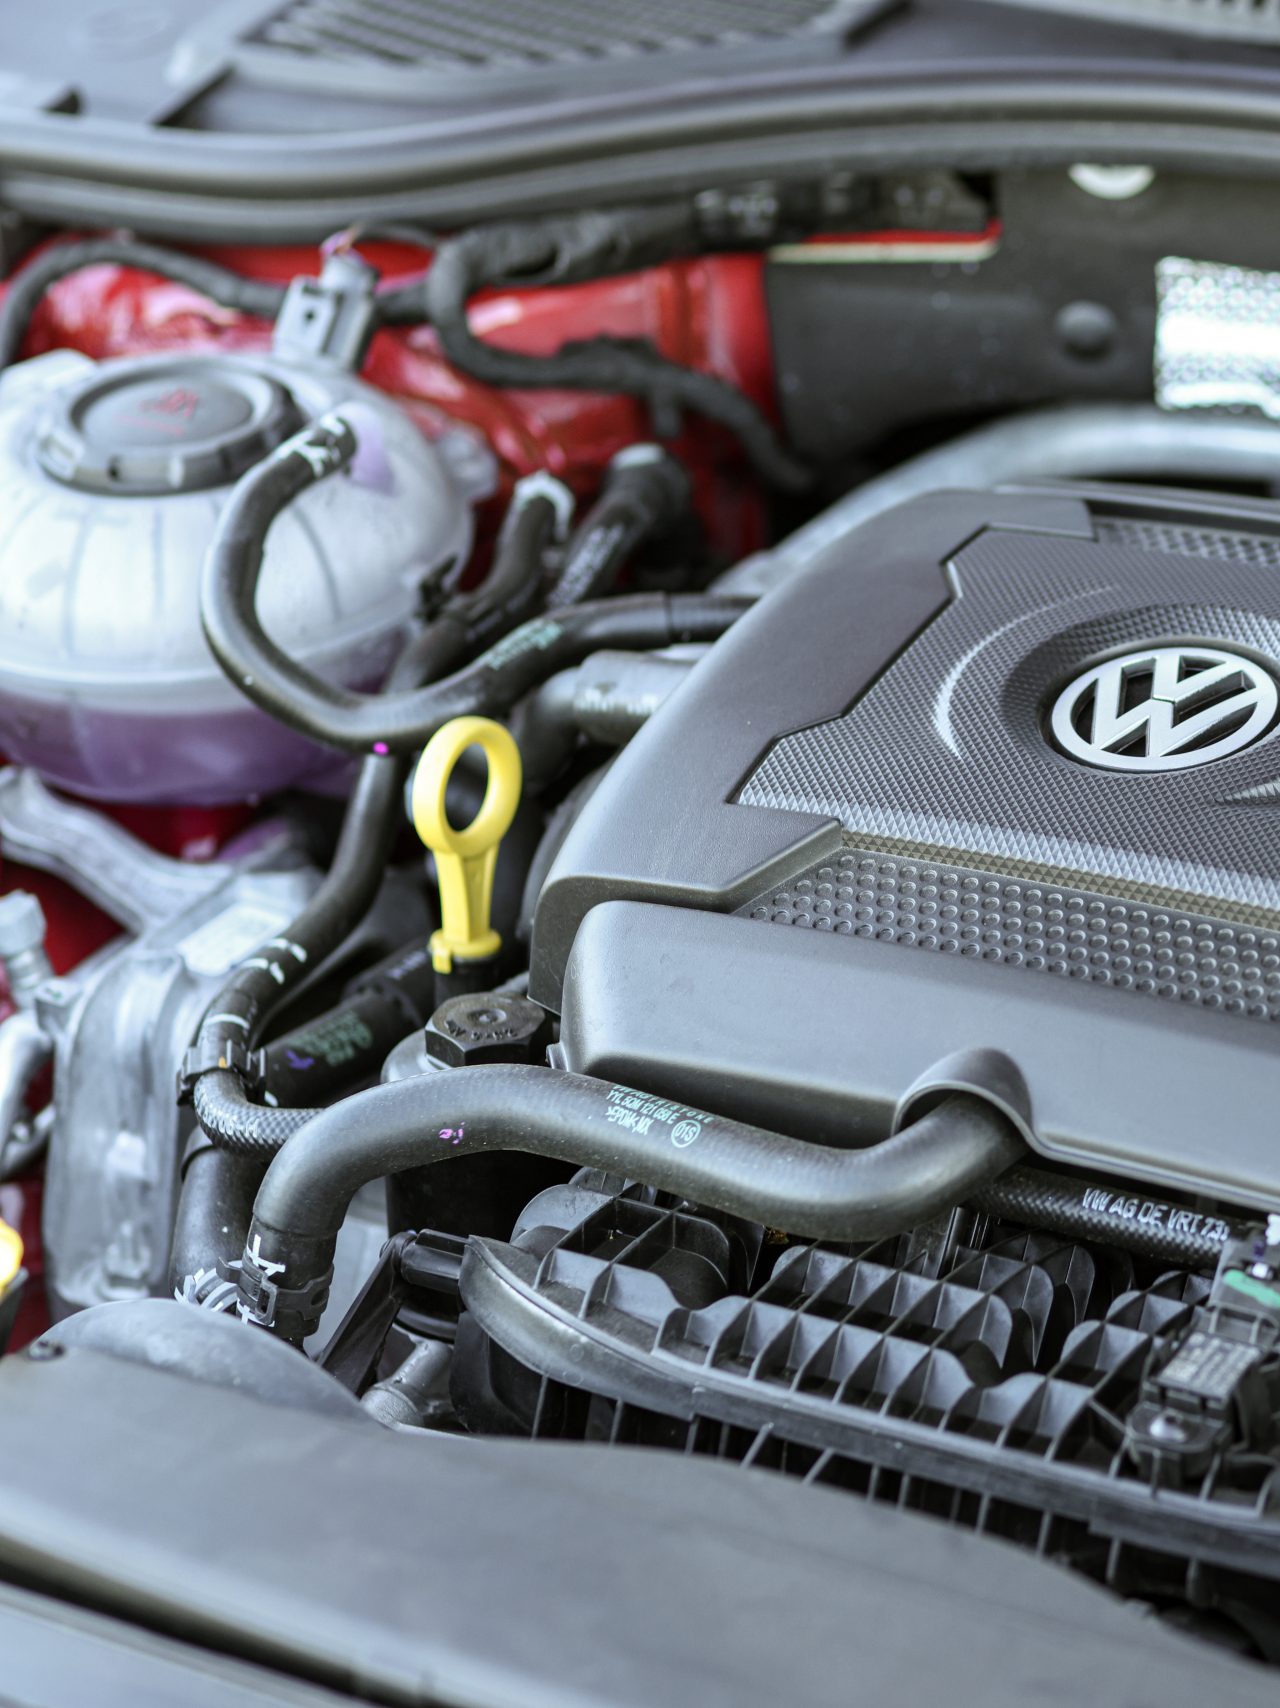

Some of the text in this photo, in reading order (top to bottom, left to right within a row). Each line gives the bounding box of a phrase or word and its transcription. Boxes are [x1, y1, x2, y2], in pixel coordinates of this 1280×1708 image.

[1051, 647, 1279, 774] VW
[1082, 1187, 1115, 1212] VW
[1108, 1196, 1140, 1219] AG
